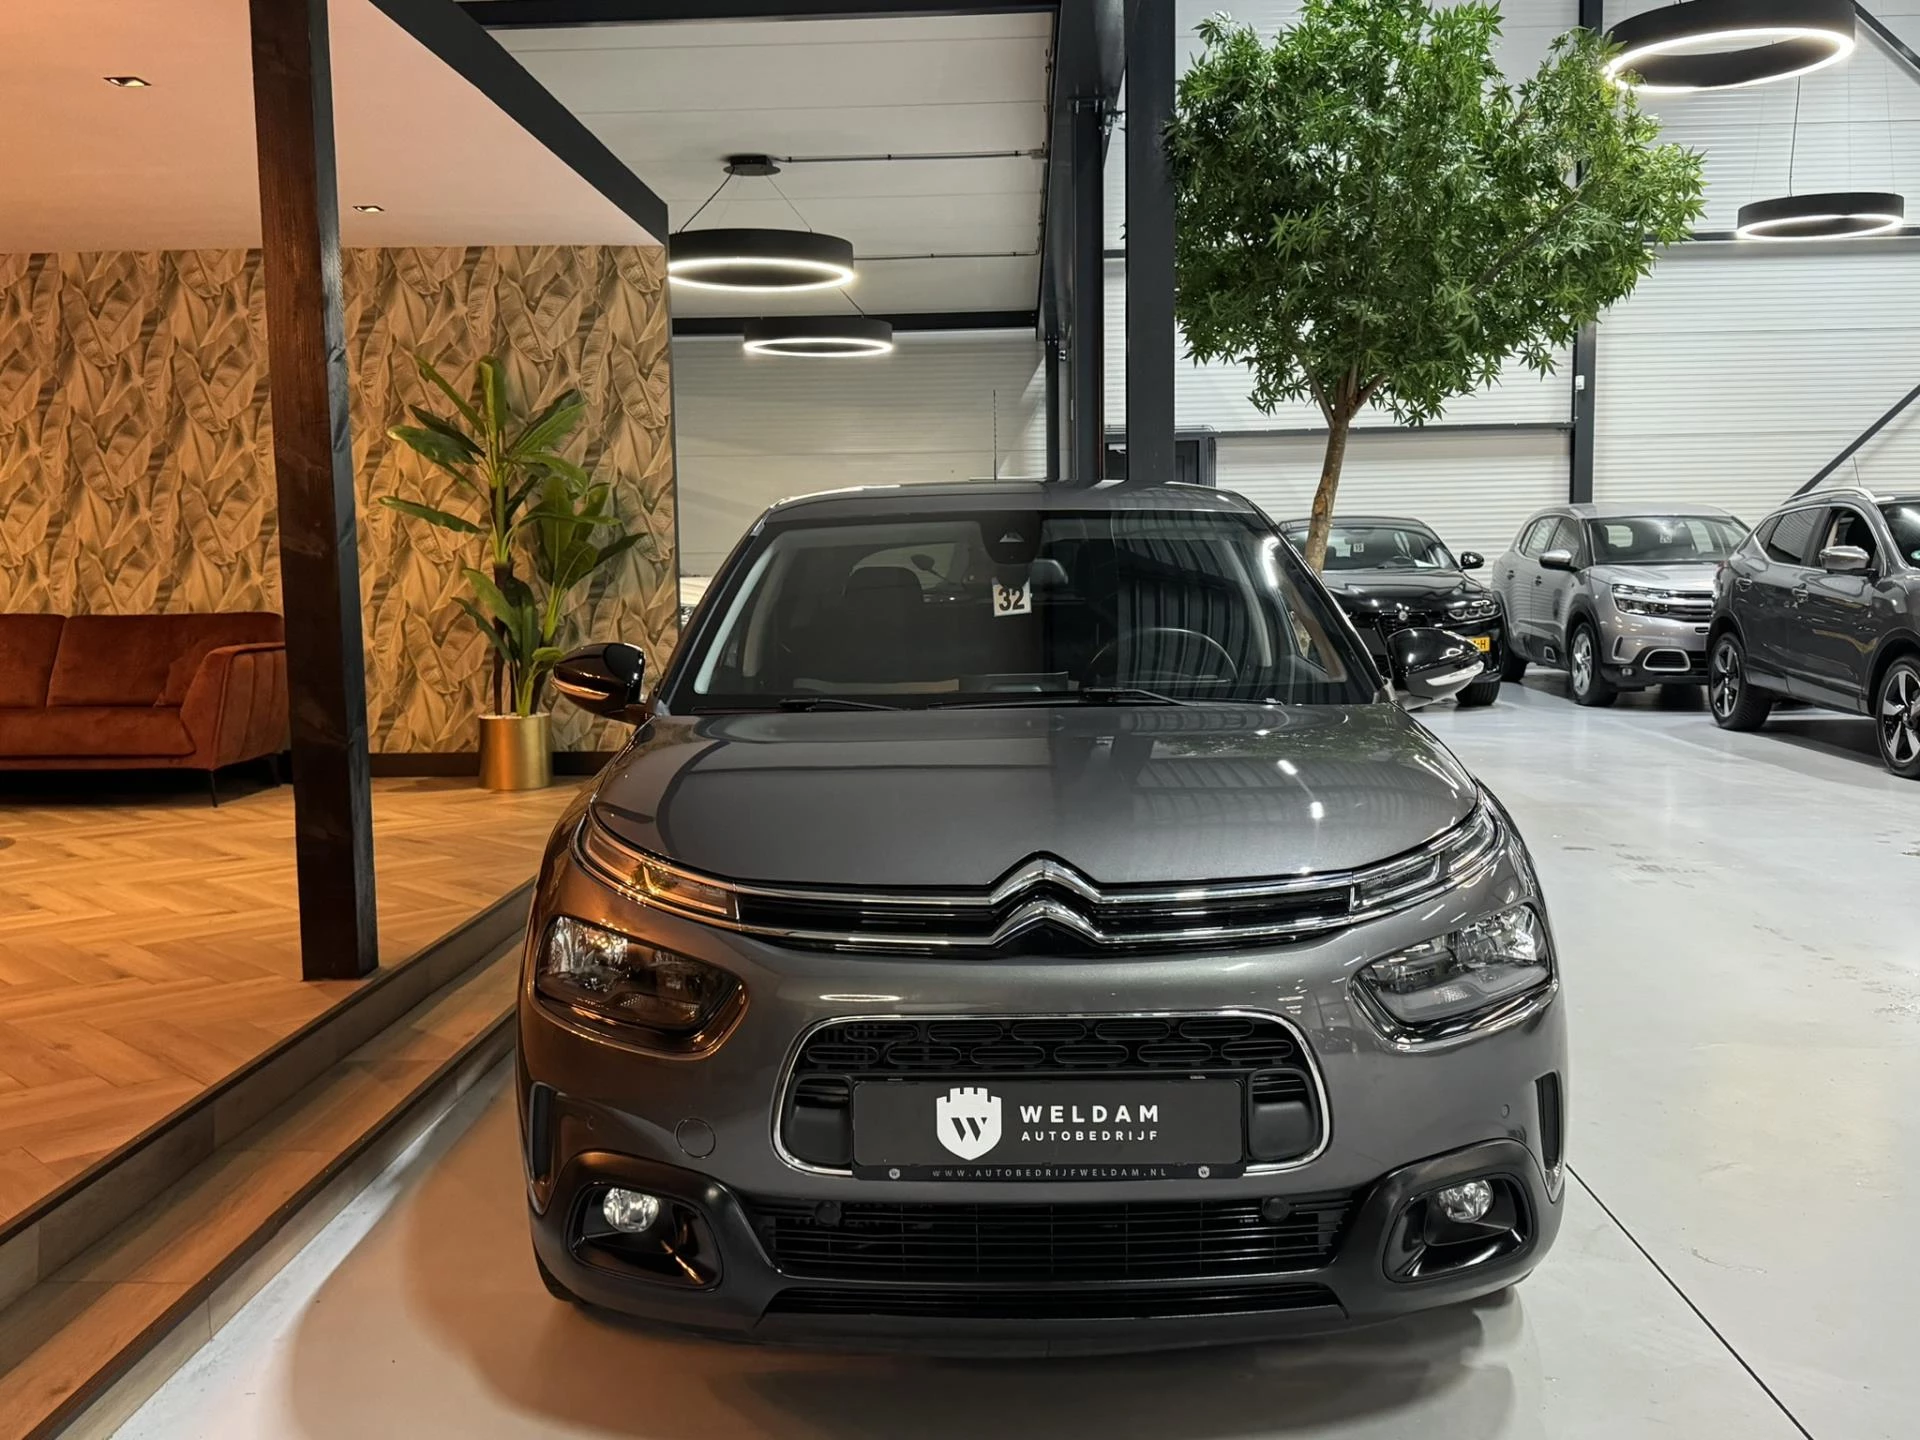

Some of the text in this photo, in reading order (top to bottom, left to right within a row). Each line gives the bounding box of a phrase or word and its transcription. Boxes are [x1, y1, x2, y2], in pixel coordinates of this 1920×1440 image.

[998, 584, 1025, 611] 32
[1020, 1105, 1159, 1123] WELDAM
[951, 1117, 987, 1142] W
[1021, 1131, 1158, 1141] AUTOBEDRIJF
[932, 1168, 1167, 1178] WWW.AUTOBEDRIJFWELDAM.NL
